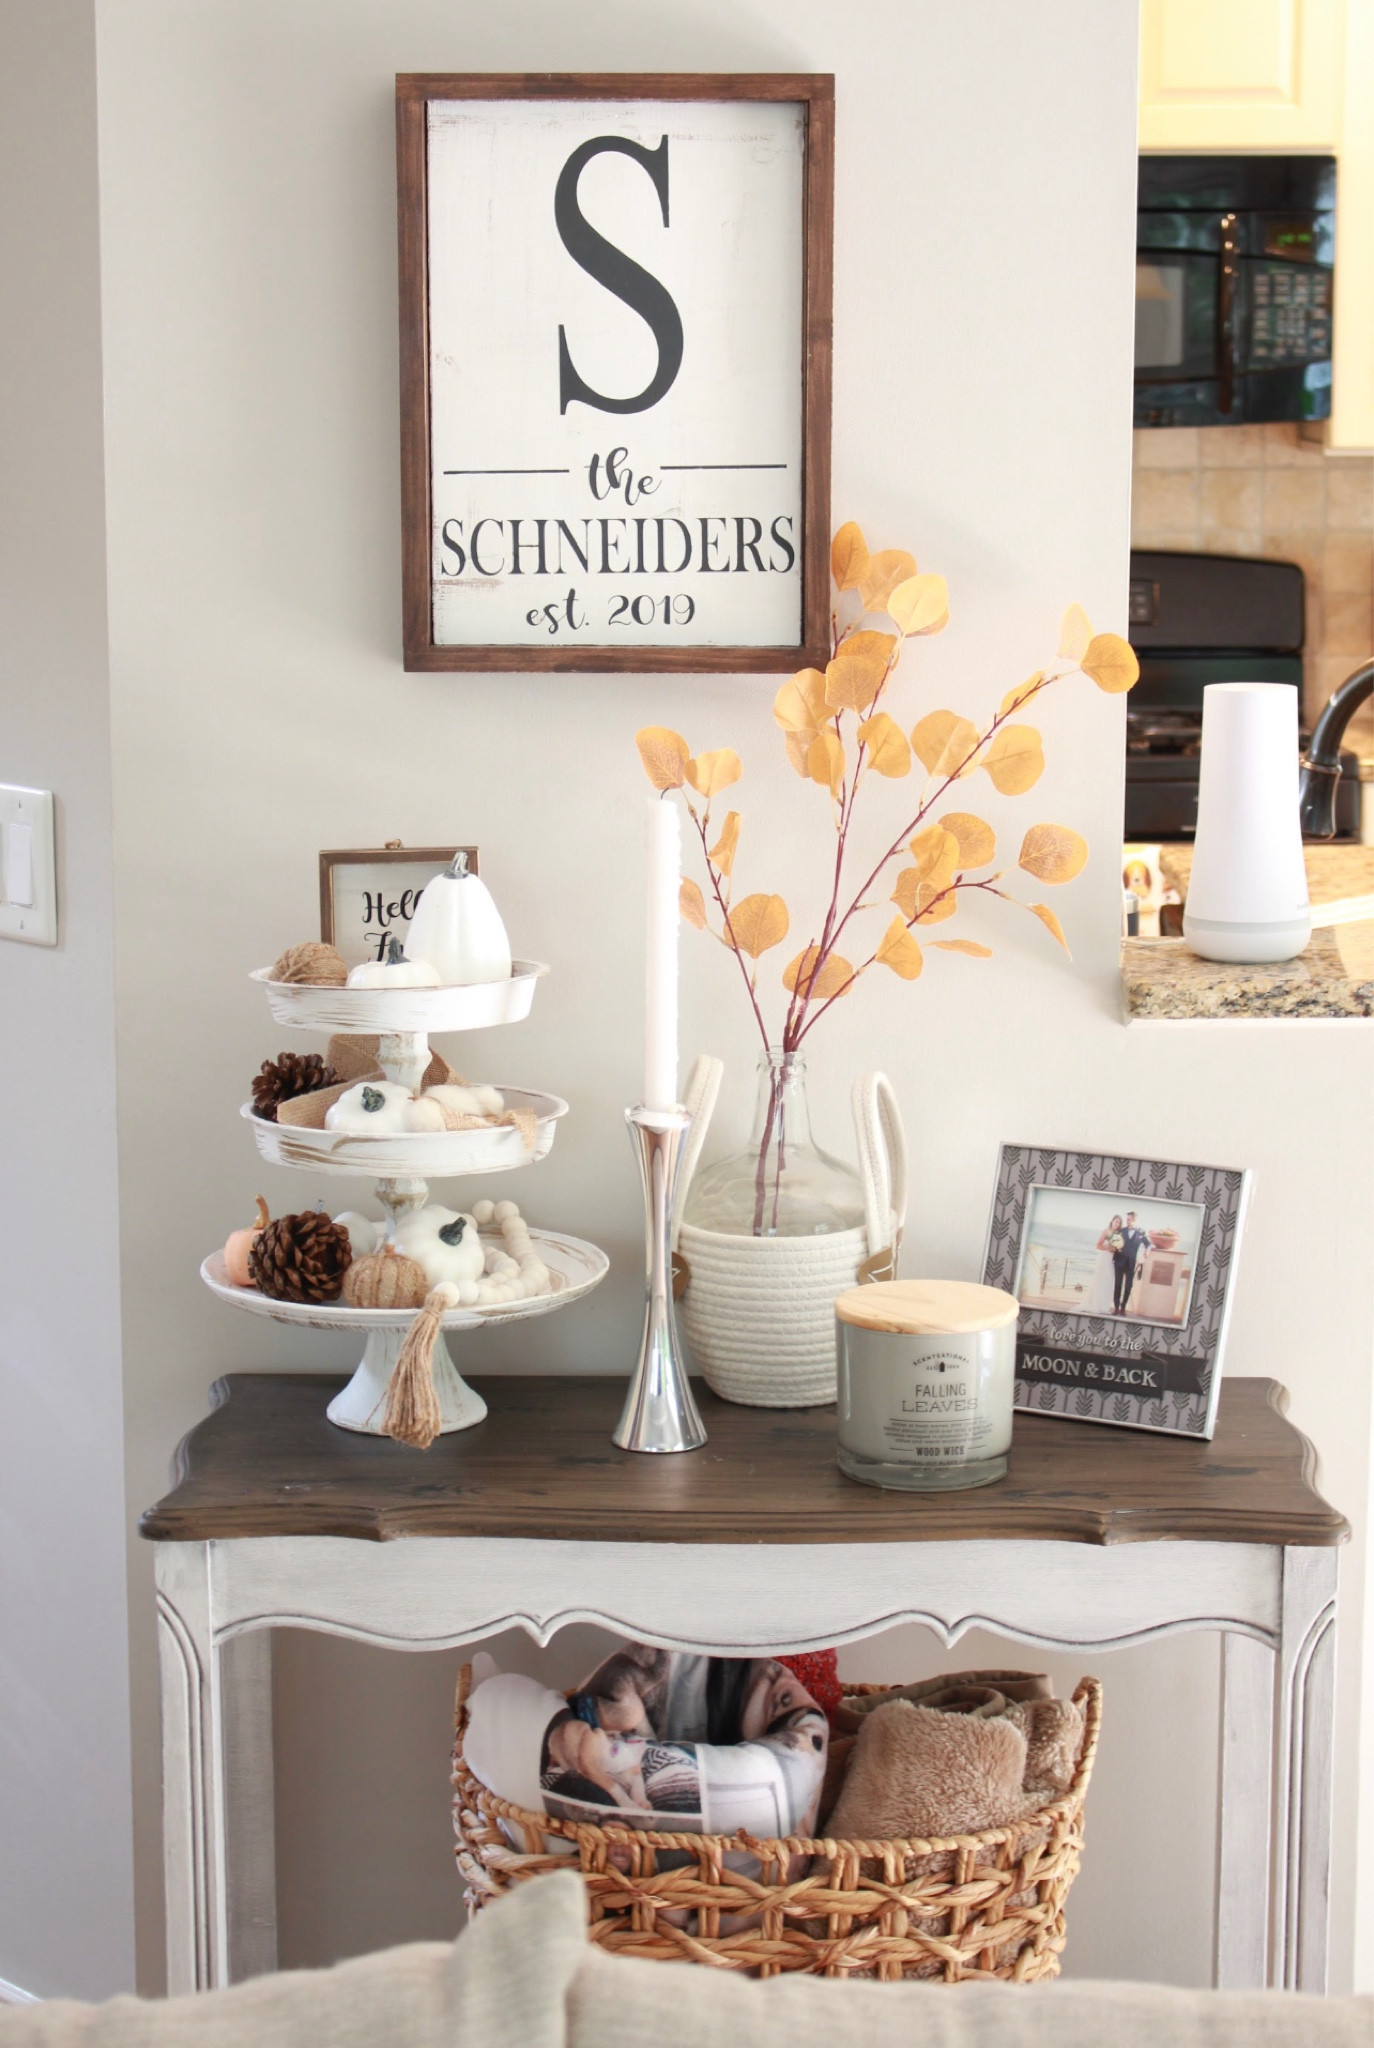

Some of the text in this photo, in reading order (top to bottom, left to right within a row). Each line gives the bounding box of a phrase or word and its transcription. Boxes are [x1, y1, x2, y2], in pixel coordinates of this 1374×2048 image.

[554, 134, 684, 415] S
[585, 447, 662, 505] the
[441, 516, 795, 576] SCHNEIDERS
[526, 588, 695, 634] est. 2019
[1077, 1334, 1102, 1347] you
[1104, 1336, 1117, 1347] to
[1121, 1336, 1142, 1351] the
[1022, 1353, 1157, 1387] MOON & BACK
[902, 1398, 978, 1413] LEAVES
[915, 1383, 966, 1398] FALLING
[916, 1446, 965, 1456] WOOD WICK
